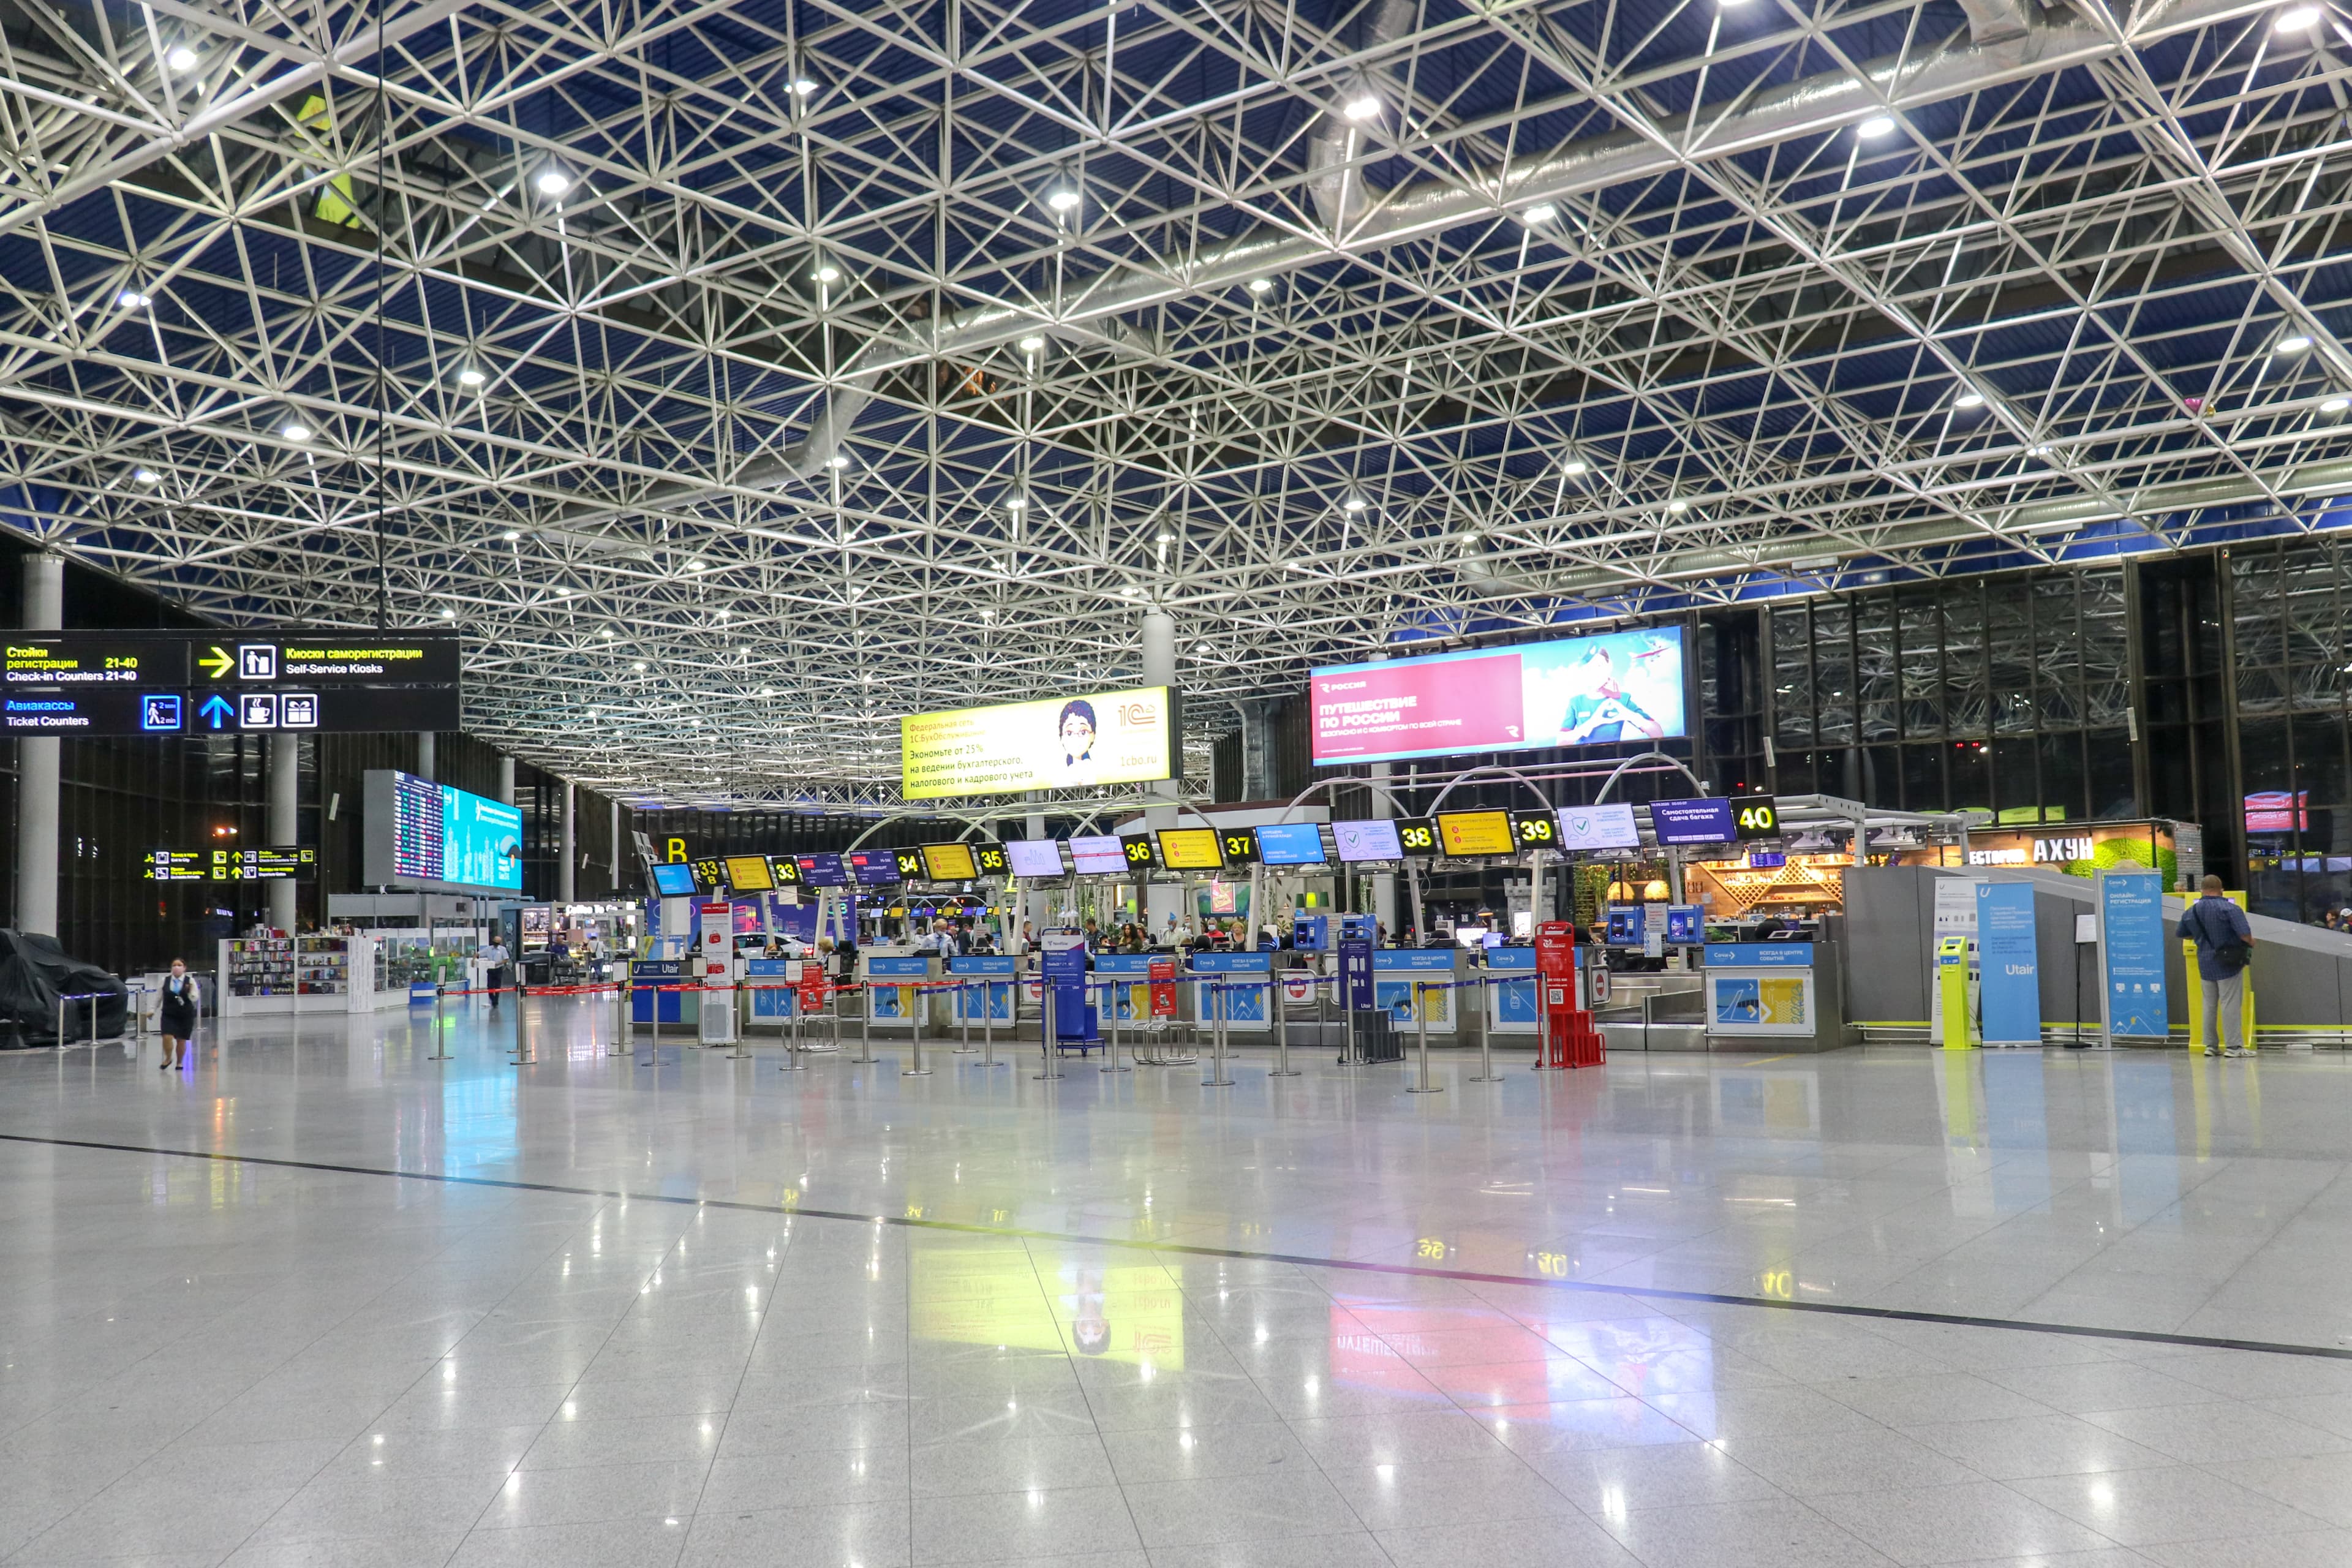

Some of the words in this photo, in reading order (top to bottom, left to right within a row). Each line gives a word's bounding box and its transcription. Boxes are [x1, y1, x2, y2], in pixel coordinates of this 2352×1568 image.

[7, 647, 48, 657] Стойки
[287, 648, 325, 658] Киоски
[327, 649, 423, 660] саморегистрации
[7, 659, 78, 669] регистрации
[105, 657, 138, 668] 21-40
[286, 664, 347, 674] Self-Service
[350, 664, 383, 674] Kiosks
[7, 672, 53, 681] Check-in
[56, 672, 104, 681] Counters
[105, 671, 137, 680] 21-40
[1331, 681, 1366, 691] РОССИЯ
[7, 701, 75, 710] Авиакассы
[1319, 696, 1417, 715] ПУТЕШЕСТВИЕ
[7, 717, 39, 726] Ticket
[40, 716, 89, 726] Counters
[1320, 717, 1339, 728] ПО
[1343, 711, 1400, 726] РОССИИ
[1420, 720, 1436, 729] ВСЕЙ
[1438, 718, 1462, 727] СТРАНЕ
[910, 720, 957, 732] Федеральная
[910, 748, 952, 760] Экономьте
[966, 744, 984, 754] 25%
[1121, 755, 1157, 766] 1cbo.ru
[922, 763, 955, 773] ведении
[910, 777, 955, 788] налогового
[965, 772, 1007, 784] кадрового
[1009, 770, 1033, 783] учета
[1740, 807, 1773, 829] 40
[1520, 820, 1551, 840] 39
[1402, 827, 1432, 847] 38
[1126, 842, 1150, 861] 36
[1226, 837, 1250, 854] 37
[2034, 837, 2095, 862] АХУН
[898, 855, 918, 872] 34
[981, 851, 1003, 868] 35
[698, 861, 718, 876] 33
[775, 864, 796, 880] 33
[707, 876, 717, 884] B
[566, 904, 593, 913] Coffee
[594, 904, 605, 913] To
[662, 964, 679, 973] Utair
[2005, 964, 2035, 975] Utair
